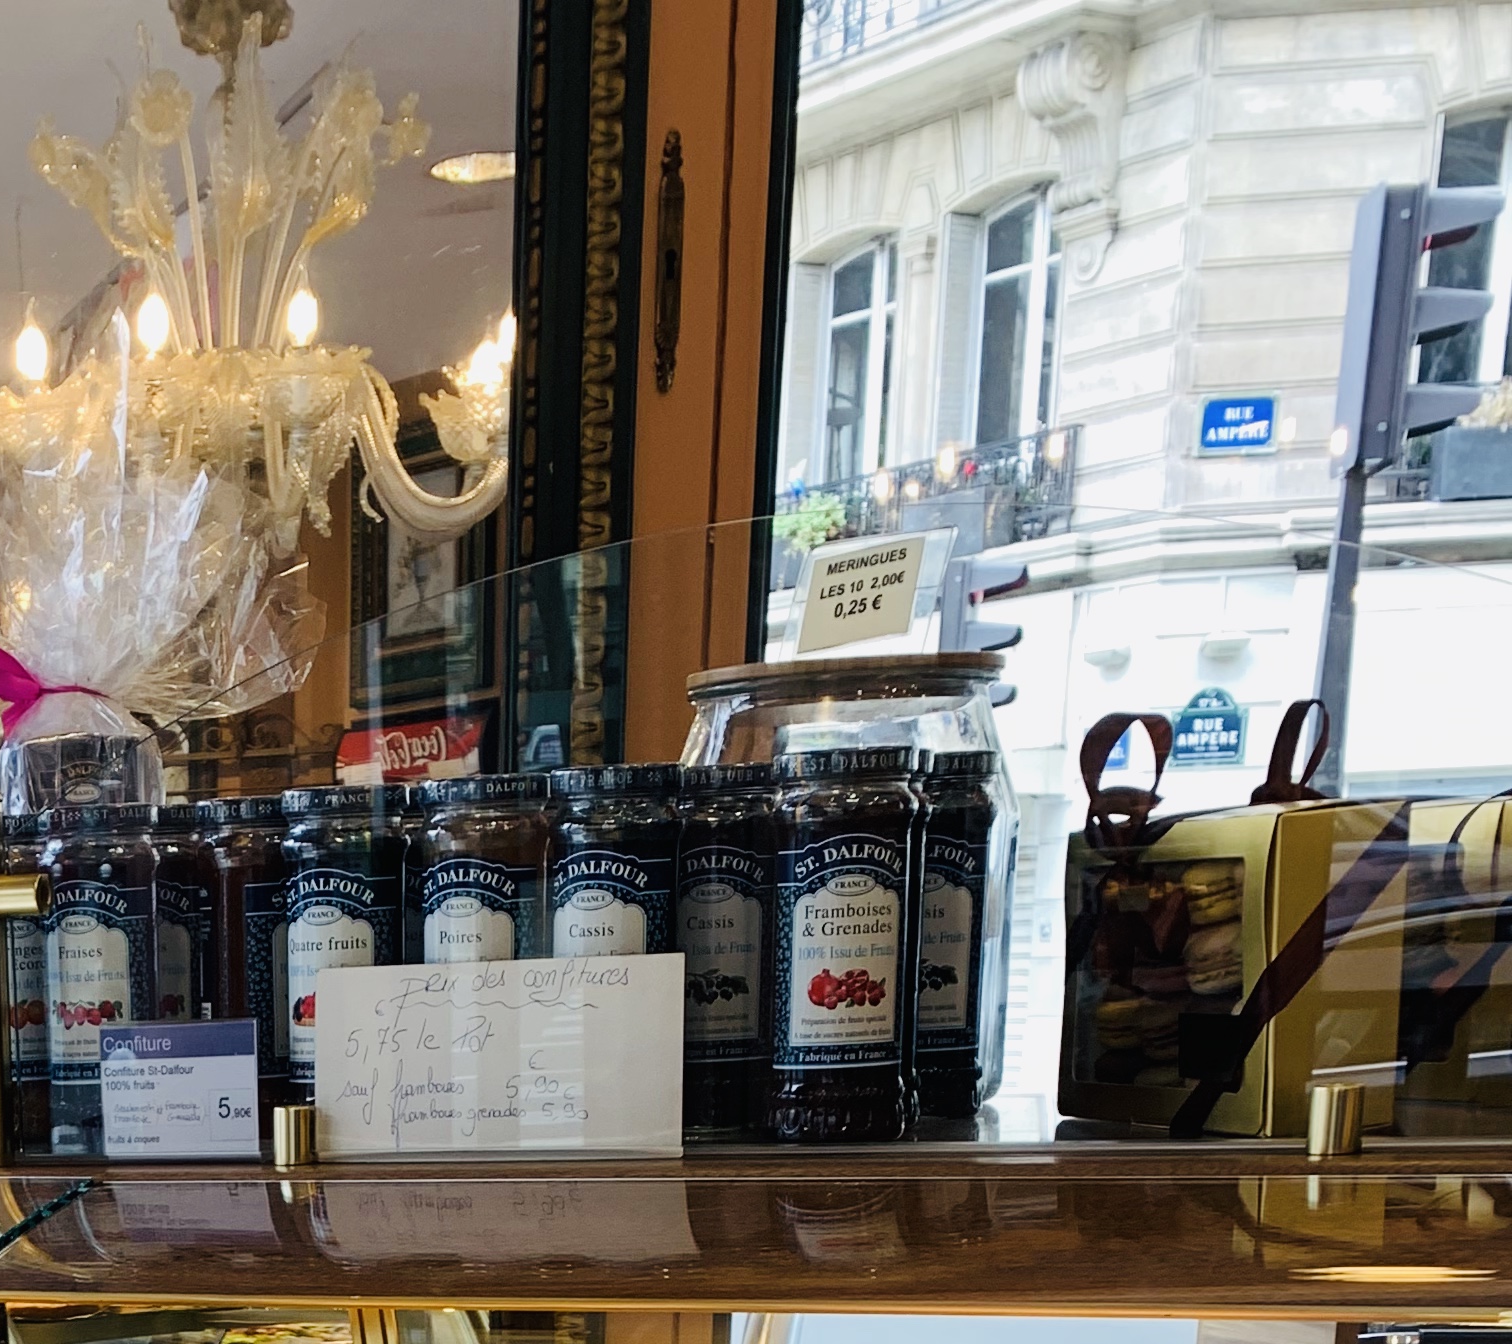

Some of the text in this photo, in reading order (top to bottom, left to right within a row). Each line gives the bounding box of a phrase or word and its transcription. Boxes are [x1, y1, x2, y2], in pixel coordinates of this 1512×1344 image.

[1224, 406, 1254, 421] RUE
[826, 547, 908, 576] MERINGUES
[820, 570, 906, 599] LES 10 2,00€
[834, 594, 883, 619] 0,25 €
[1193, 717, 1224, 731] RUE
[840, 754, 904, 769] DALFOU
[687, 854, 765, 884] DALFOUR
[795, 843, 903, 879] ST. DALFOUR
[438, 867, 516, 897] DALFOUR
[568, 859, 649, 889] DALFOUR
[299, 877, 376, 905] DALFOUR
[835, 878, 869, 889] FRANCE
[56, 887, 128, 915] DALFOUR
[446, 901, 474, 911] FRANCE
[805, 904, 892, 921] Framboises
[925, 903, 945, 918] sis
[569, 923, 615, 938] Cassis
[687, 913, 735, 930] Cassis
[803, 918, 893, 937] & Grenades
[290, 936, 368, 955] Quatre fruits
[439, 930, 482, 944] Poires
[58, 945, 103, 961] Fraises
[830, 944, 852, 958] Issu
[854, 943, 868, 957] de
[471, 960, 507, 989] des
[524, 958, 631, 1001] confitures
[103, 1036, 172, 1054] Confiture
[346, 1026, 409, 1064] 5,75
[417, 1019, 441, 1050] le
[799, 1049, 887, 1063] Fabriqué France
[104, 1065, 195, 1078] Confiture St-Dalfour
[105, 1080, 156, 1091] 100% fruits
[506, 1075, 560, 1101] 5,90
[218, 1097, 252, 1119] 5,90€
